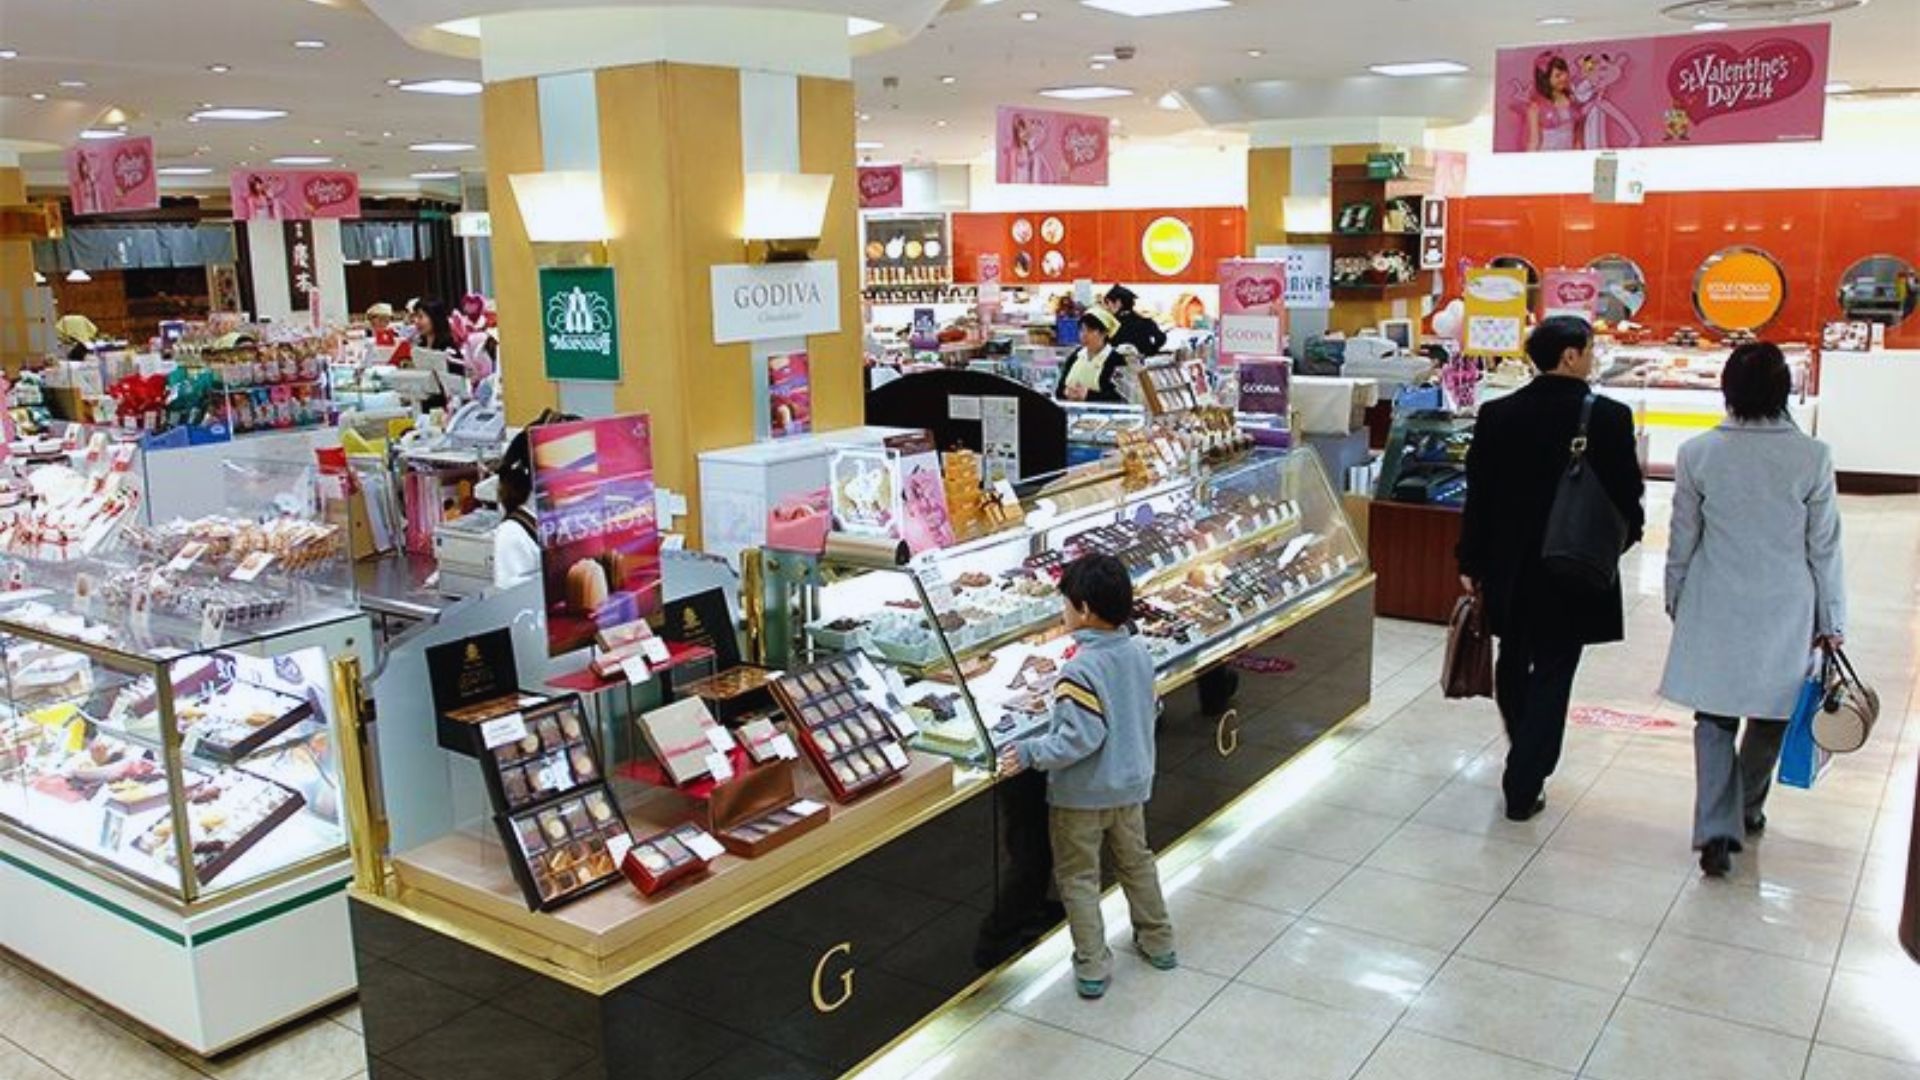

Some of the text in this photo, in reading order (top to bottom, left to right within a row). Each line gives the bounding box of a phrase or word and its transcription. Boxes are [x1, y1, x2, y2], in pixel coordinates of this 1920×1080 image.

[1693, 54, 1789, 88] Valentine's
[1707, 83, 1744, 107] Day
[733, 282, 821, 310] GODIVA
[541, 501, 655, 548] PASSION
[1216, 708, 1239, 756] G
[812, 941, 855, 1012] G
